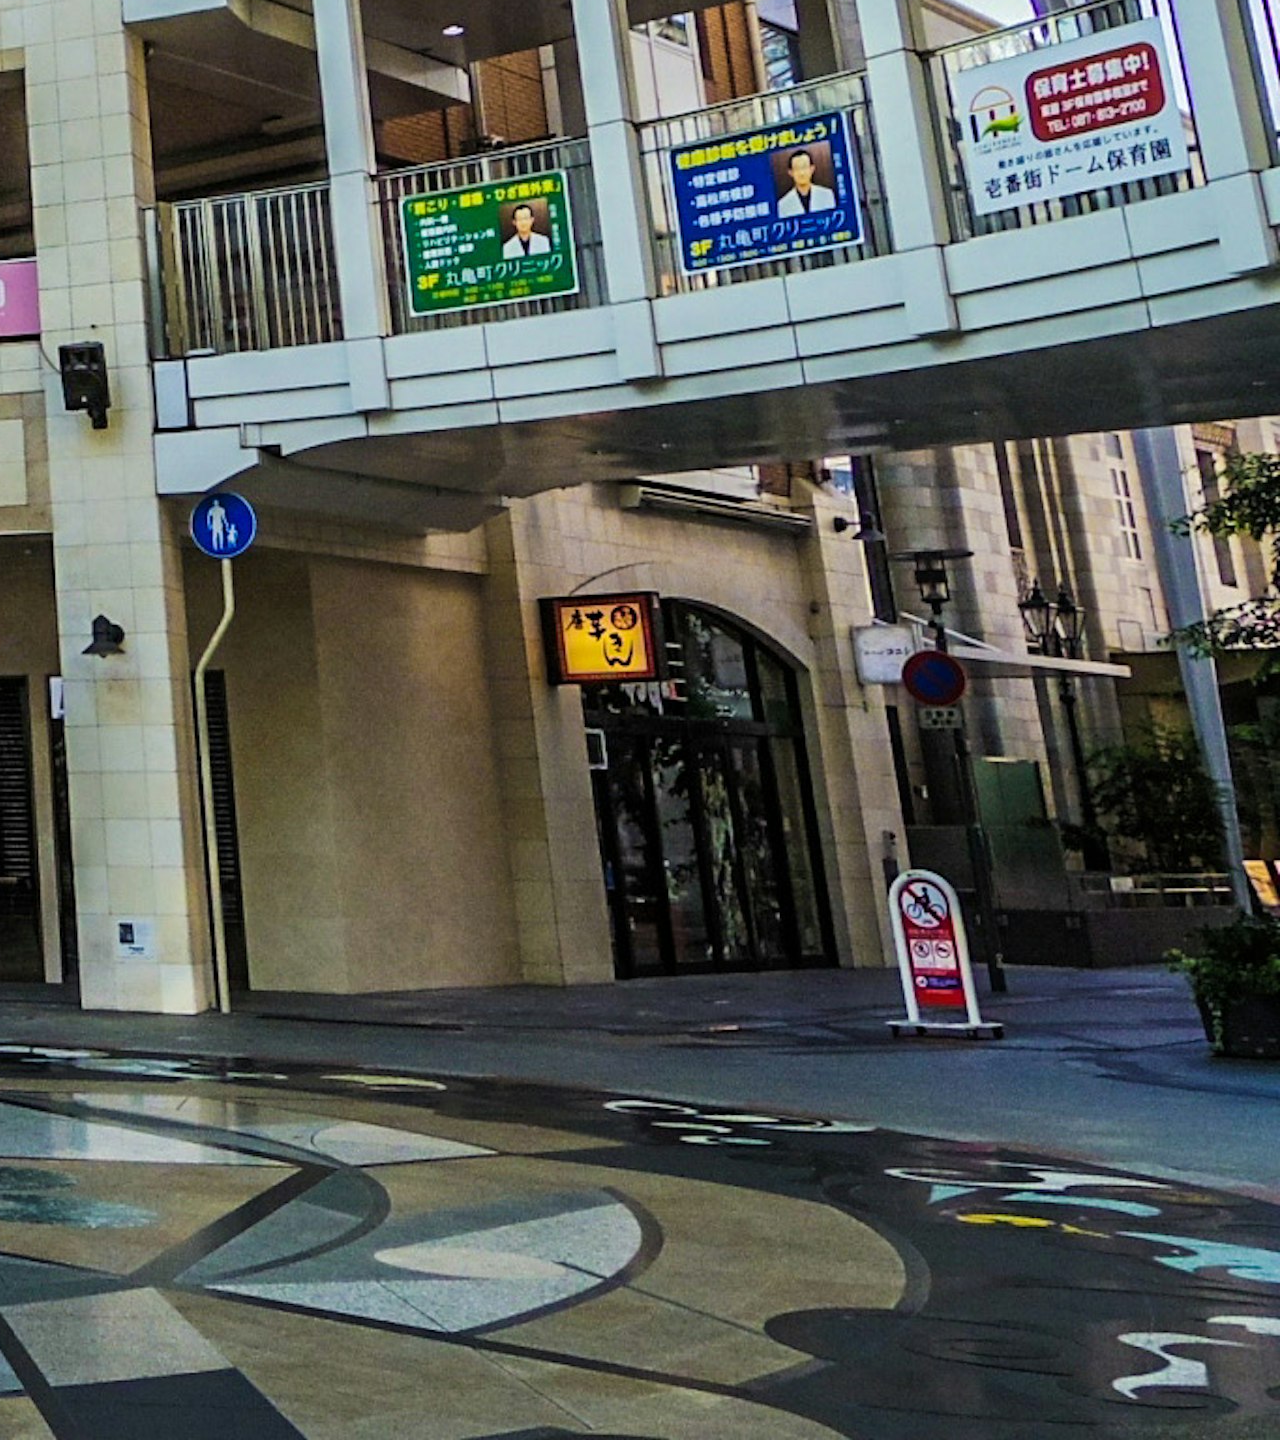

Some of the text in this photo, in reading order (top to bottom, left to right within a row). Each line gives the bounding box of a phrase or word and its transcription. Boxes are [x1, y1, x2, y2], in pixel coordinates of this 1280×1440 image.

[984, 137, 1172, 199] 壱番街ドーム保育園
[690, 239, 713, 257] 3F
[718, 210, 845, 249] 丸亀町クリニック
[417, 274, 440, 290] 3F
[446, 254, 563, 286] 丸亀町クリニック
